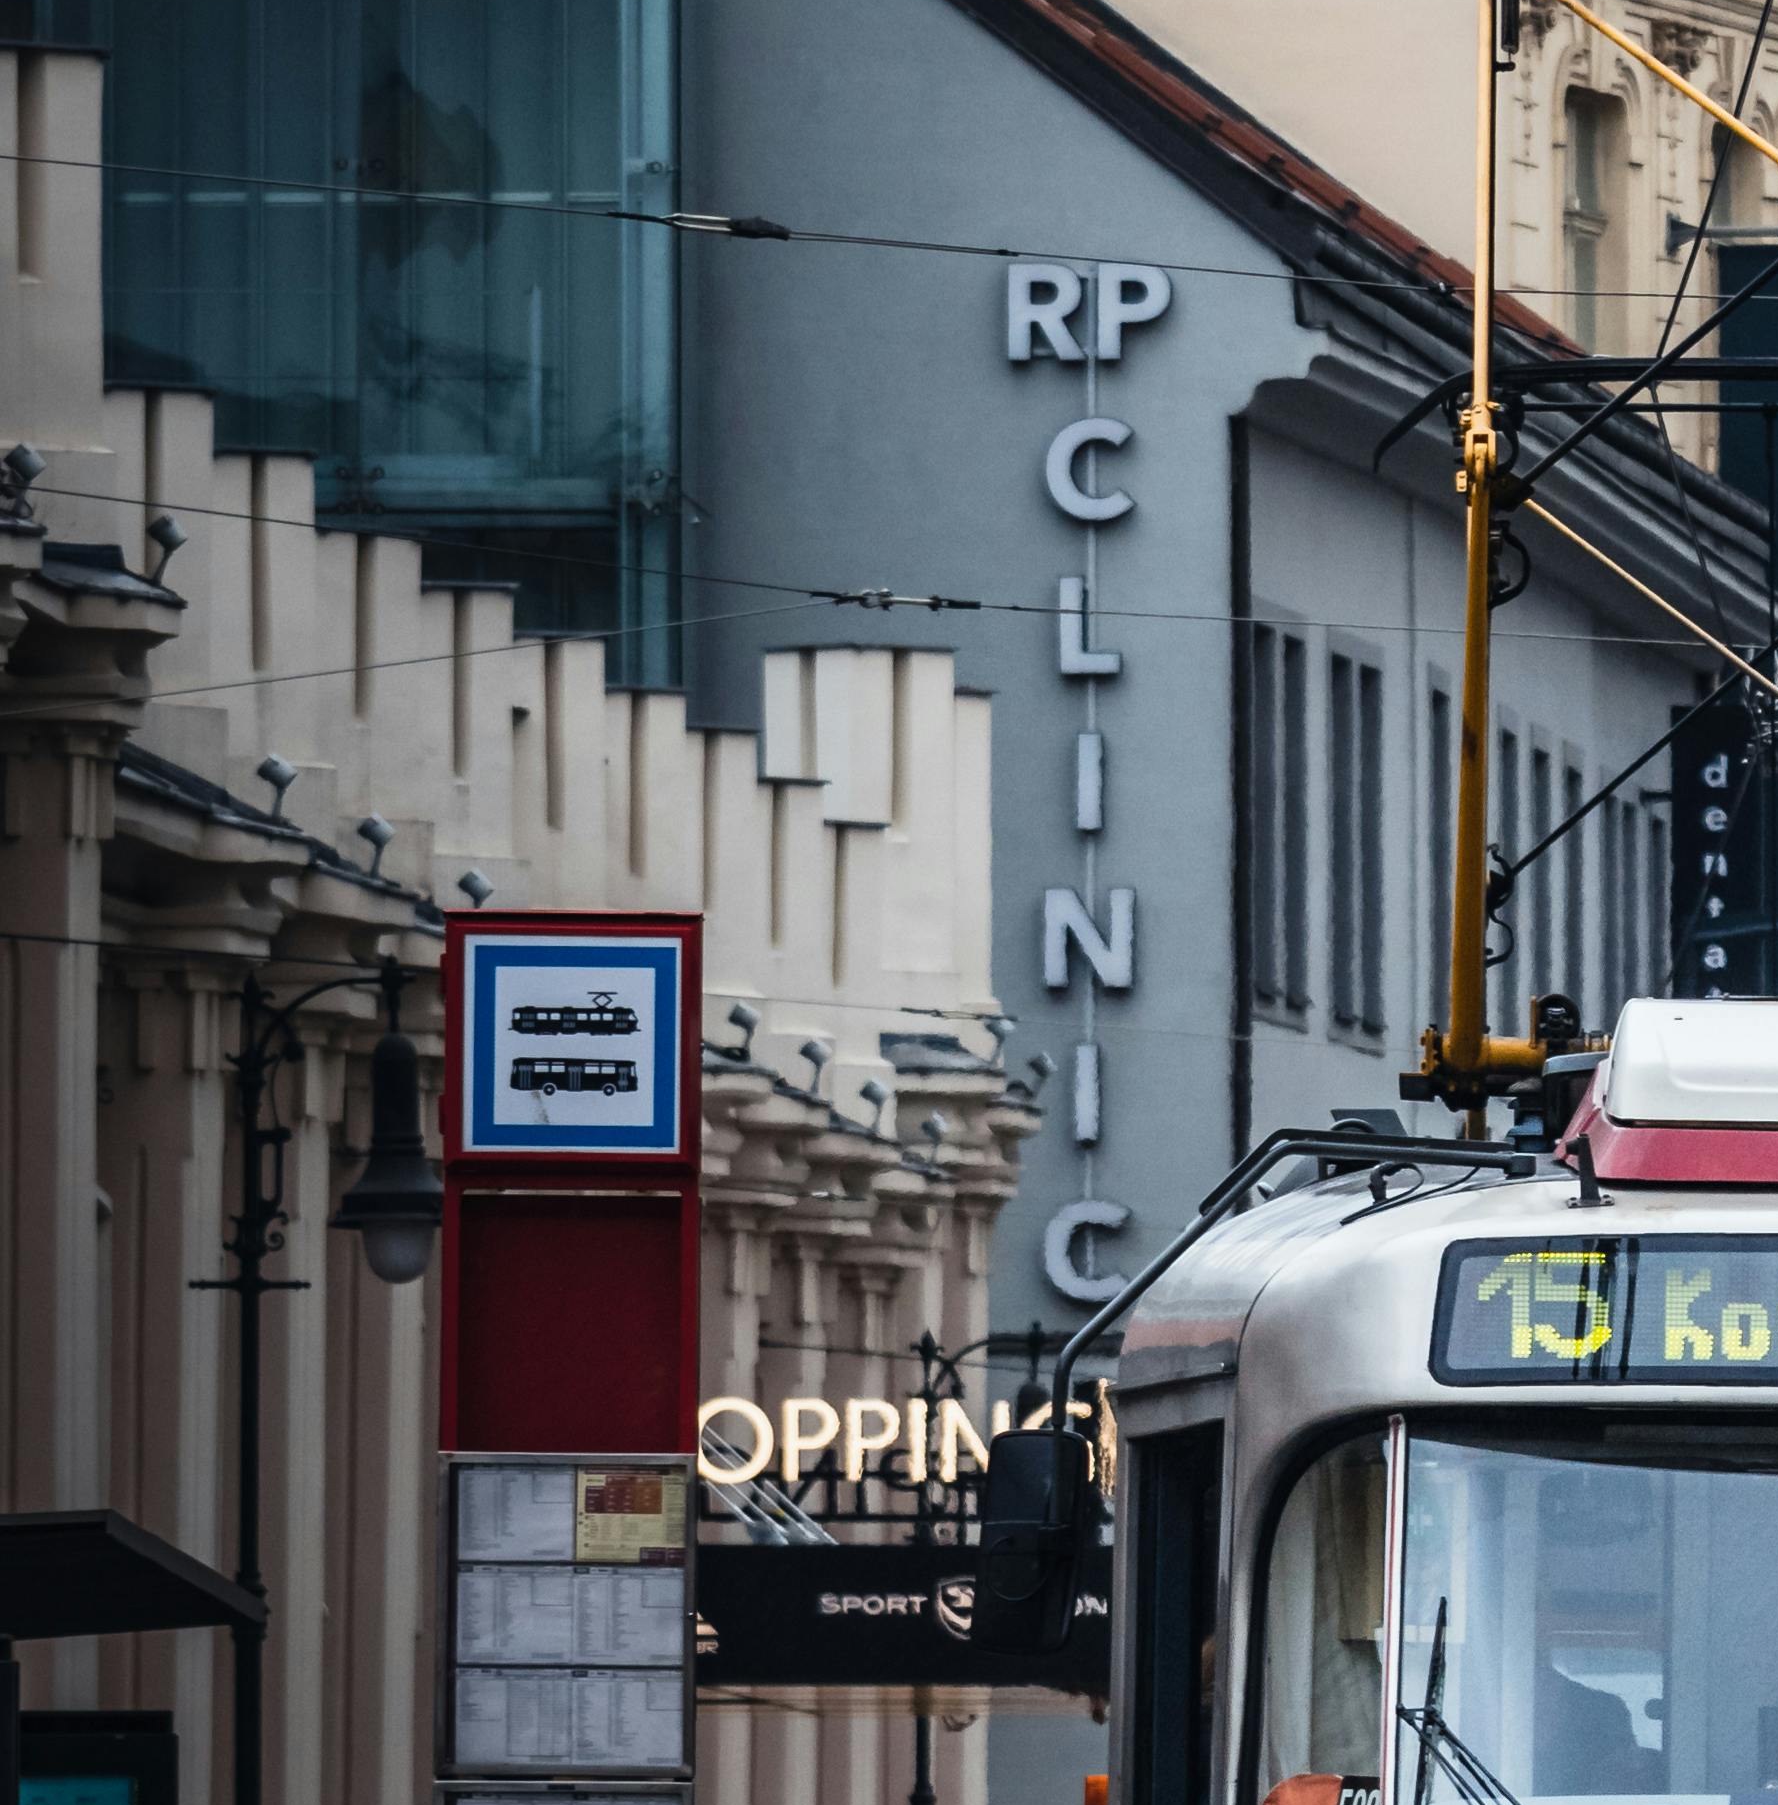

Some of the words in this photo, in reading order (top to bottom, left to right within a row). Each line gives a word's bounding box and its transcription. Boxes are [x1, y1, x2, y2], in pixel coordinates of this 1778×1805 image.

[1006, 260, 1172, 364] RP
[1043, 416, 1137, 1304] CLINIC
[1478, 1251, 1613, 1359] 15
[817, 1592, 928, 1617] SPORT
